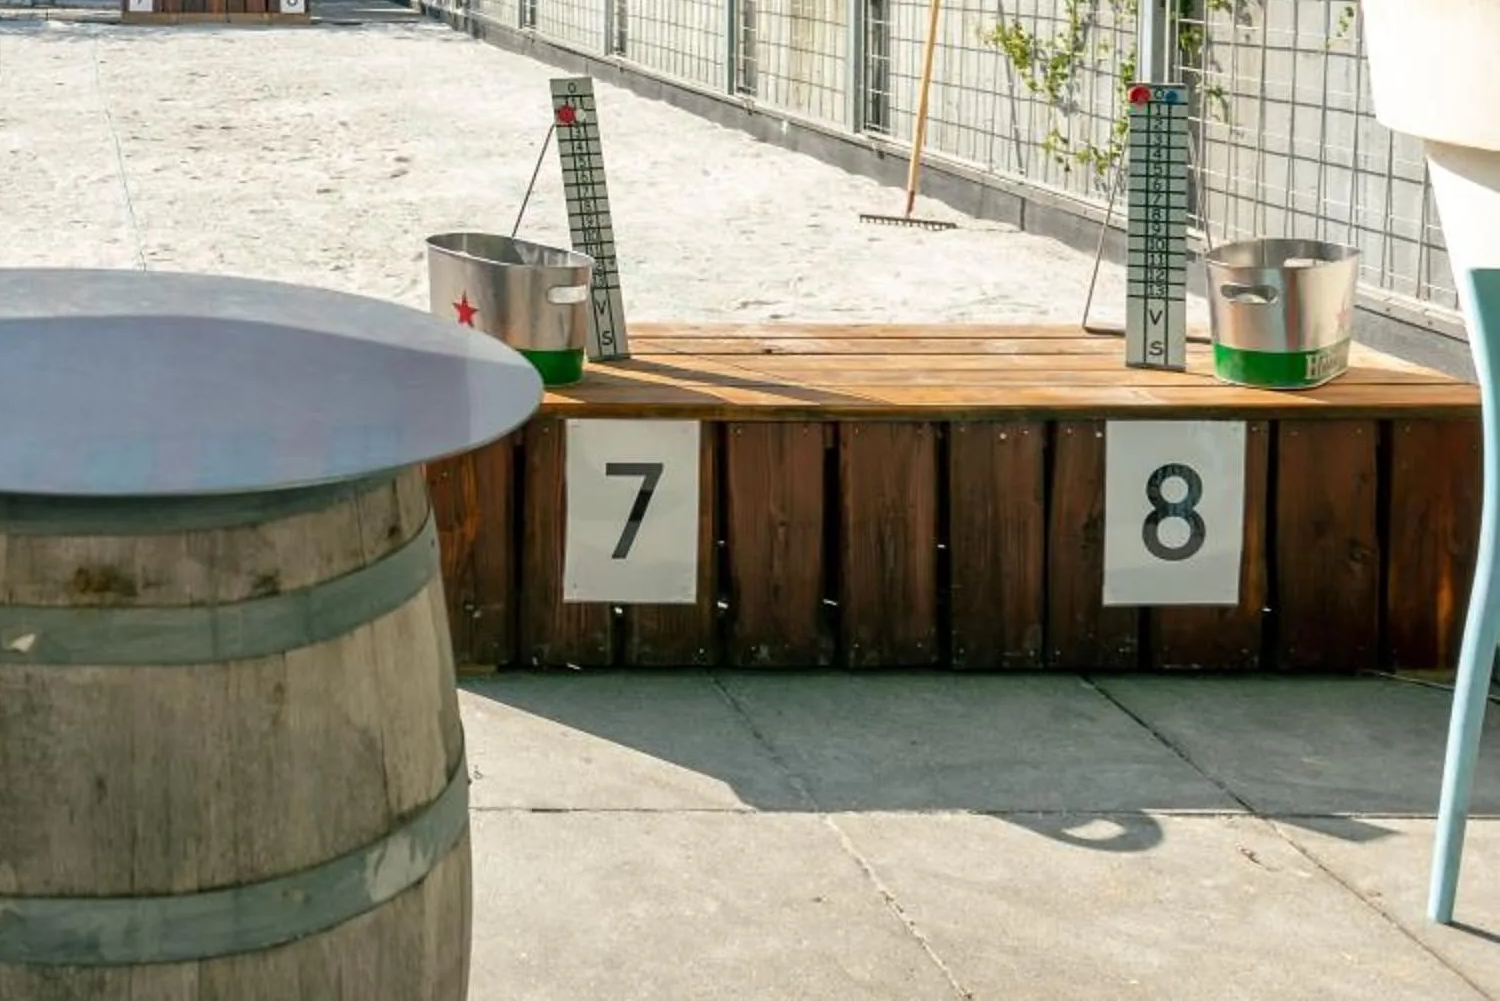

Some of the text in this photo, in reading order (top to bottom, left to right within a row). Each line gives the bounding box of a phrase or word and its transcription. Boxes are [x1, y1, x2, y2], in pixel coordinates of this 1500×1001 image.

[596, 299, 607, 315] V
[1149, 309, 1163, 326] V
[602, 330, 613, 347] S
[1149, 340, 1164, 356] S
[605, 462, 665, 559] 7
[1142, 462, 1207, 561] 8
